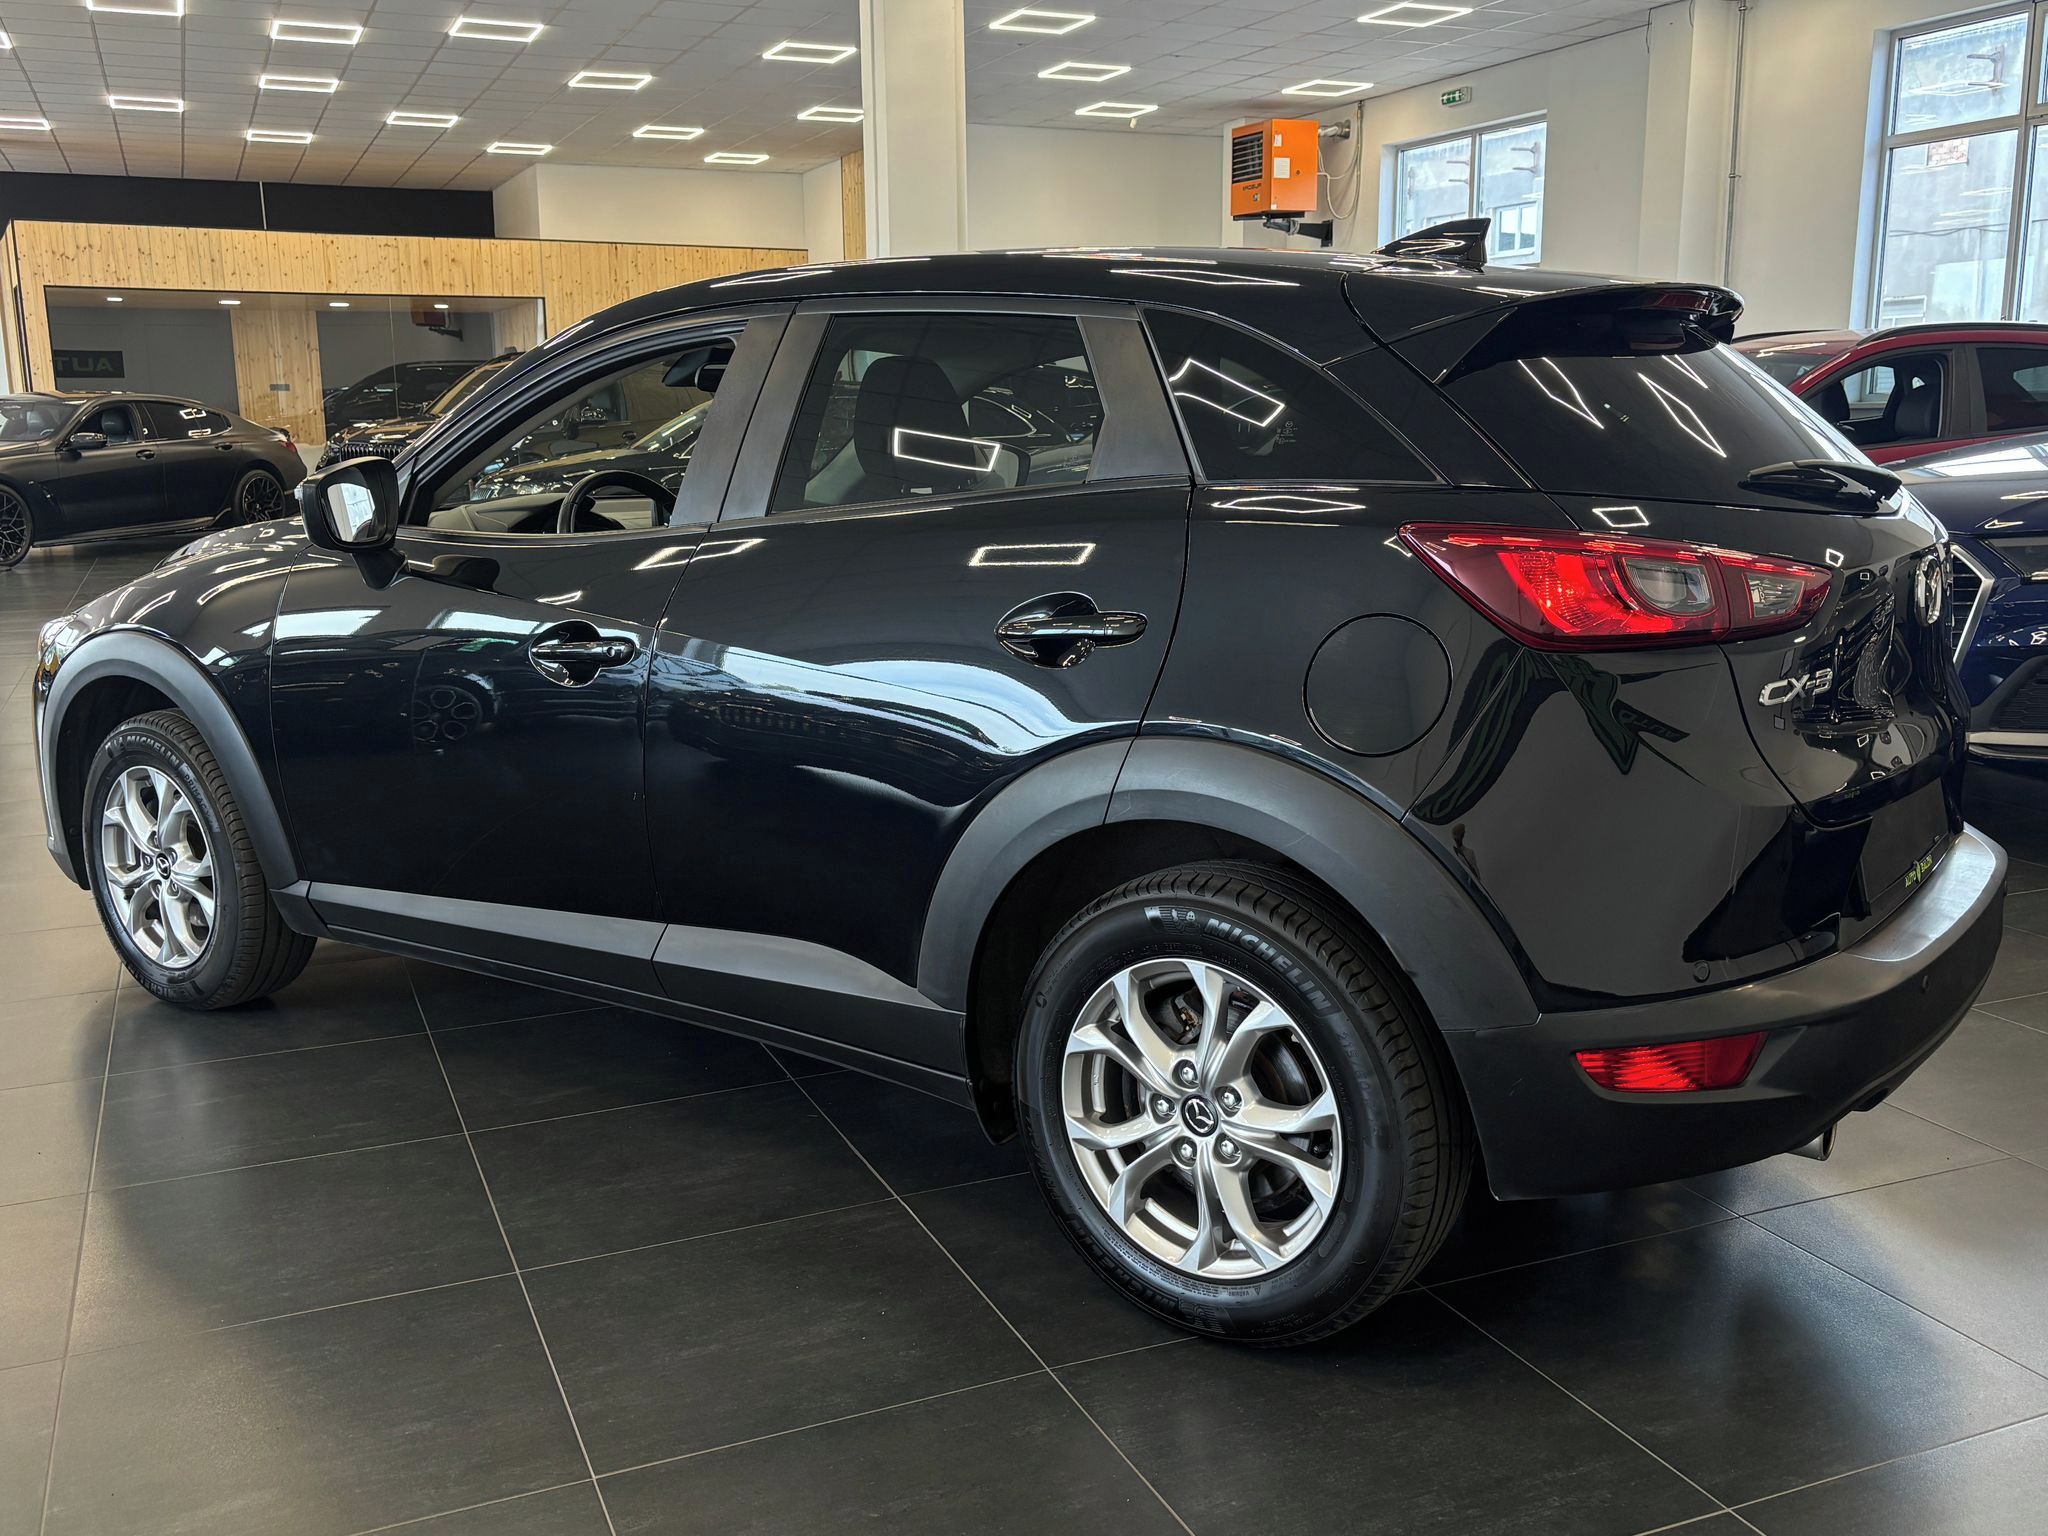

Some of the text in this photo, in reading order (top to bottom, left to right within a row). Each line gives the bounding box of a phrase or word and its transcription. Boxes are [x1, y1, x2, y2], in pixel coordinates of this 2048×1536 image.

[1759, 668, 1834, 706] CX-3
[126, 736, 180, 767] MICHELIN
[1204, 918, 1332, 1011] MICHELIN
